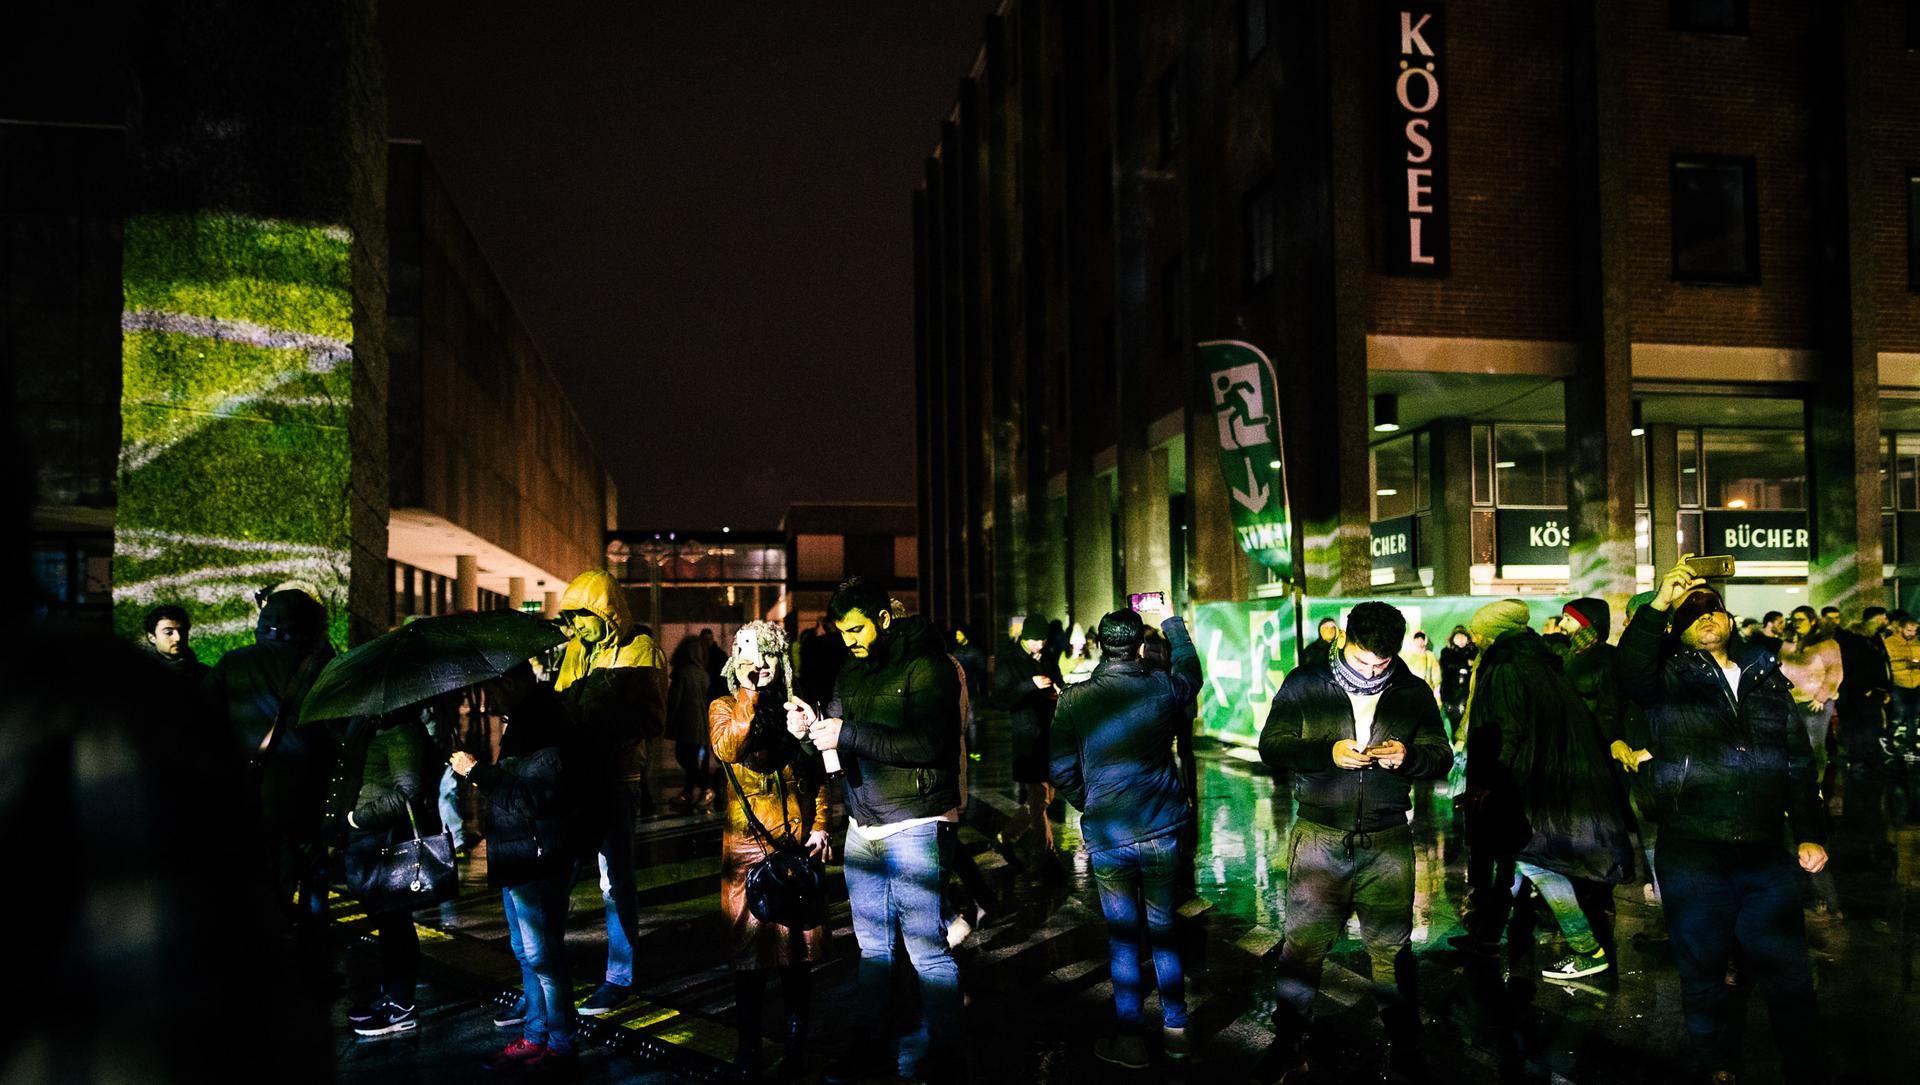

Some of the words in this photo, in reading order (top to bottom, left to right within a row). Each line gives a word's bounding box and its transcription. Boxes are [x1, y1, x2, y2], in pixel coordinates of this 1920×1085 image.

[1396, 11, 1439, 264] KÖSEL
[1370, 533, 1407, 557] CHER
[1724, 523, 1809, 548] BÜCHER
